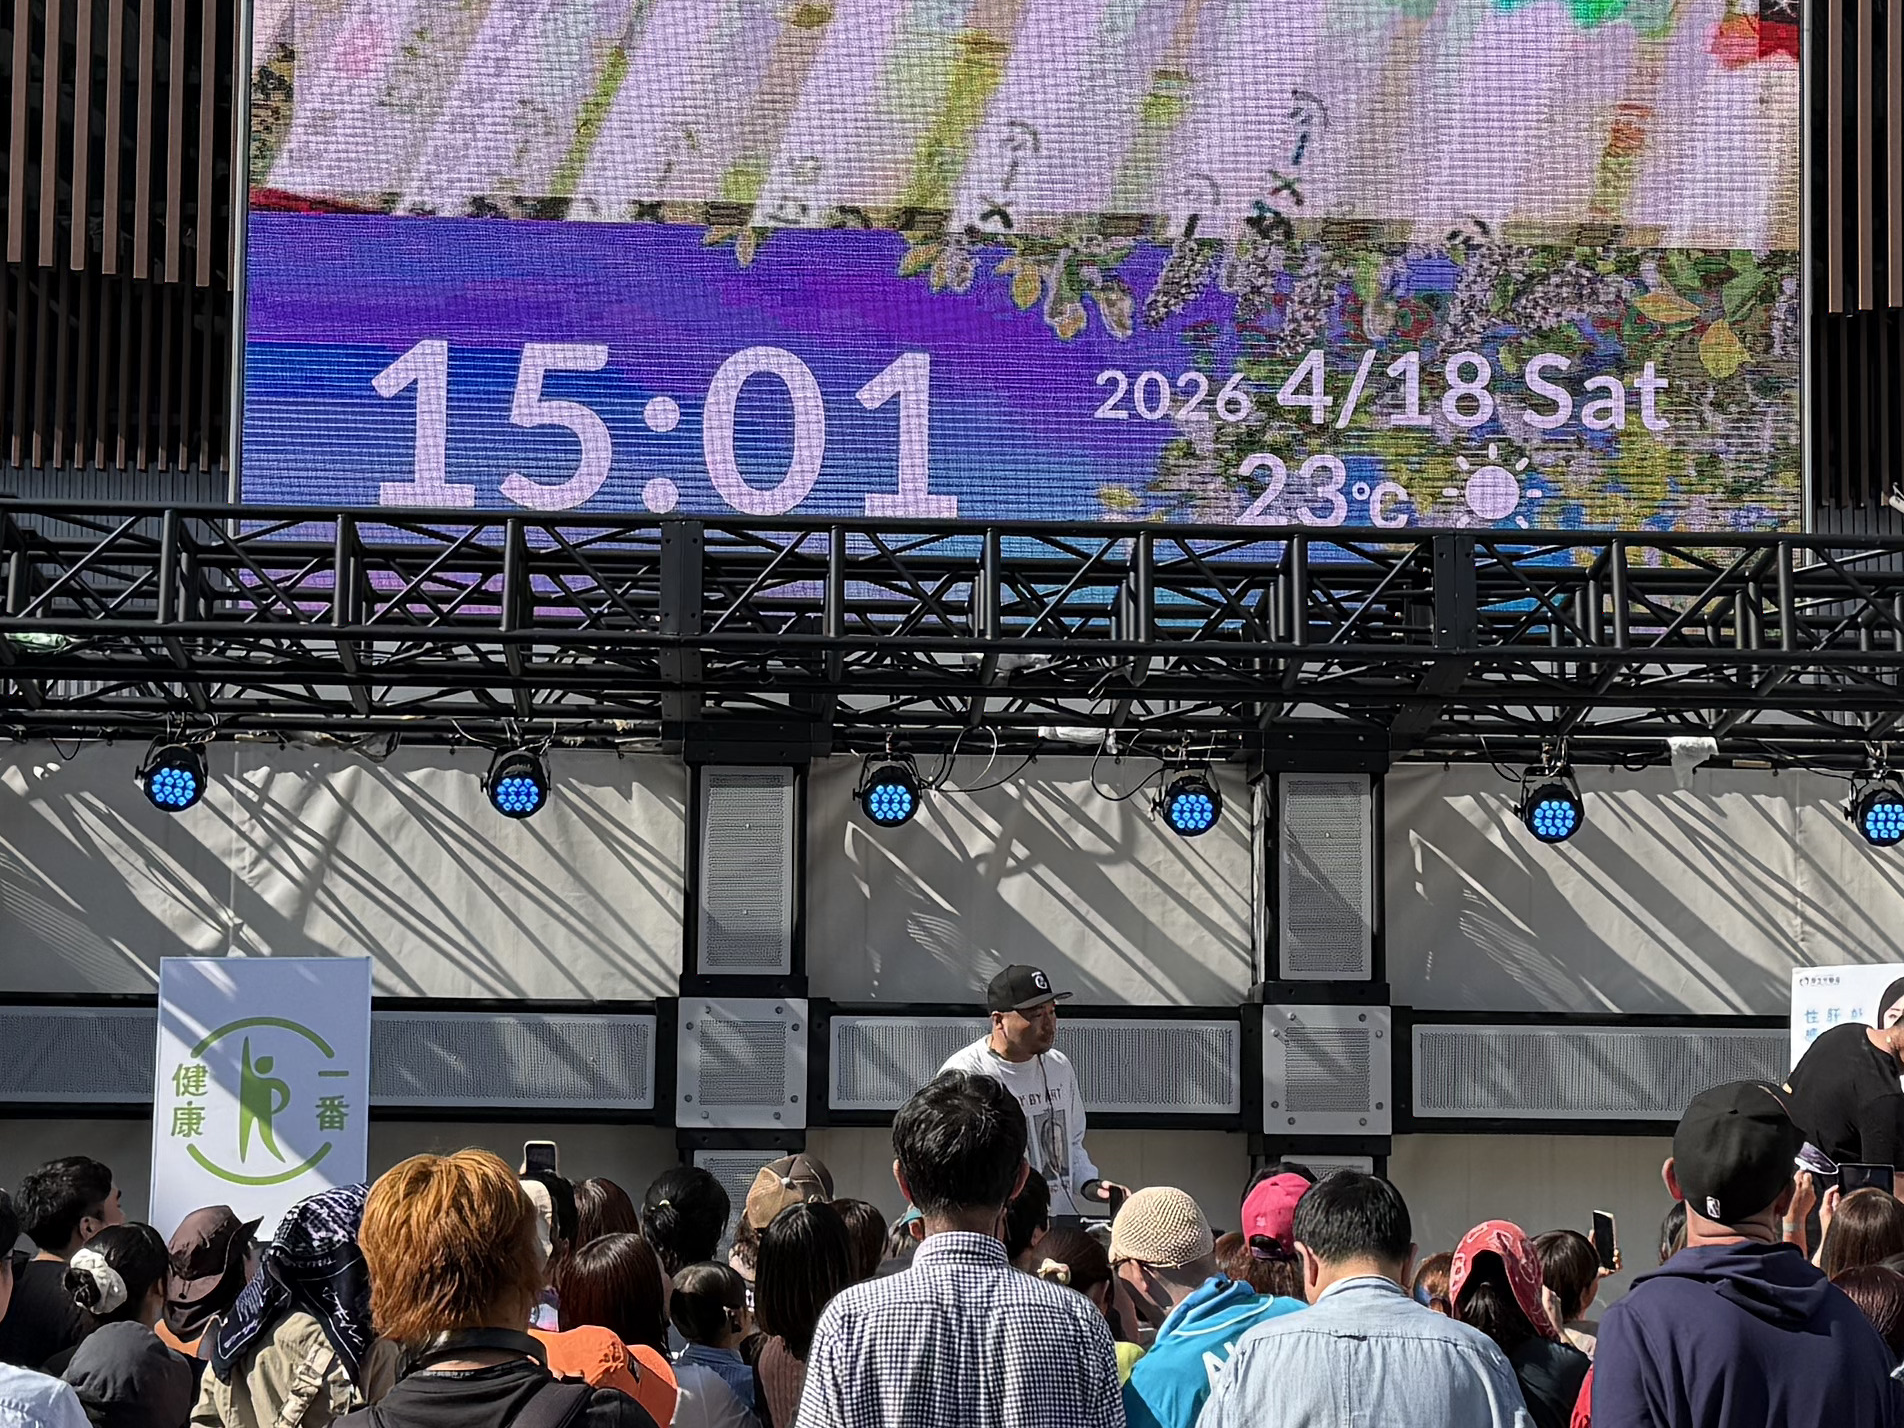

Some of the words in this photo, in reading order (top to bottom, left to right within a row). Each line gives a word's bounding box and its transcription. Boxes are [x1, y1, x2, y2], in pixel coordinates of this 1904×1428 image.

[370, 339, 959, 519] 15:01
[1092, 369, 1252, 422] 2026
[1277, 348, 1495, 430] 4/18
[1523, 351, 1672, 432] Sat
[170, 1062, 209, 1138] 健康
[315, 1069, 351, 1133] 一番
